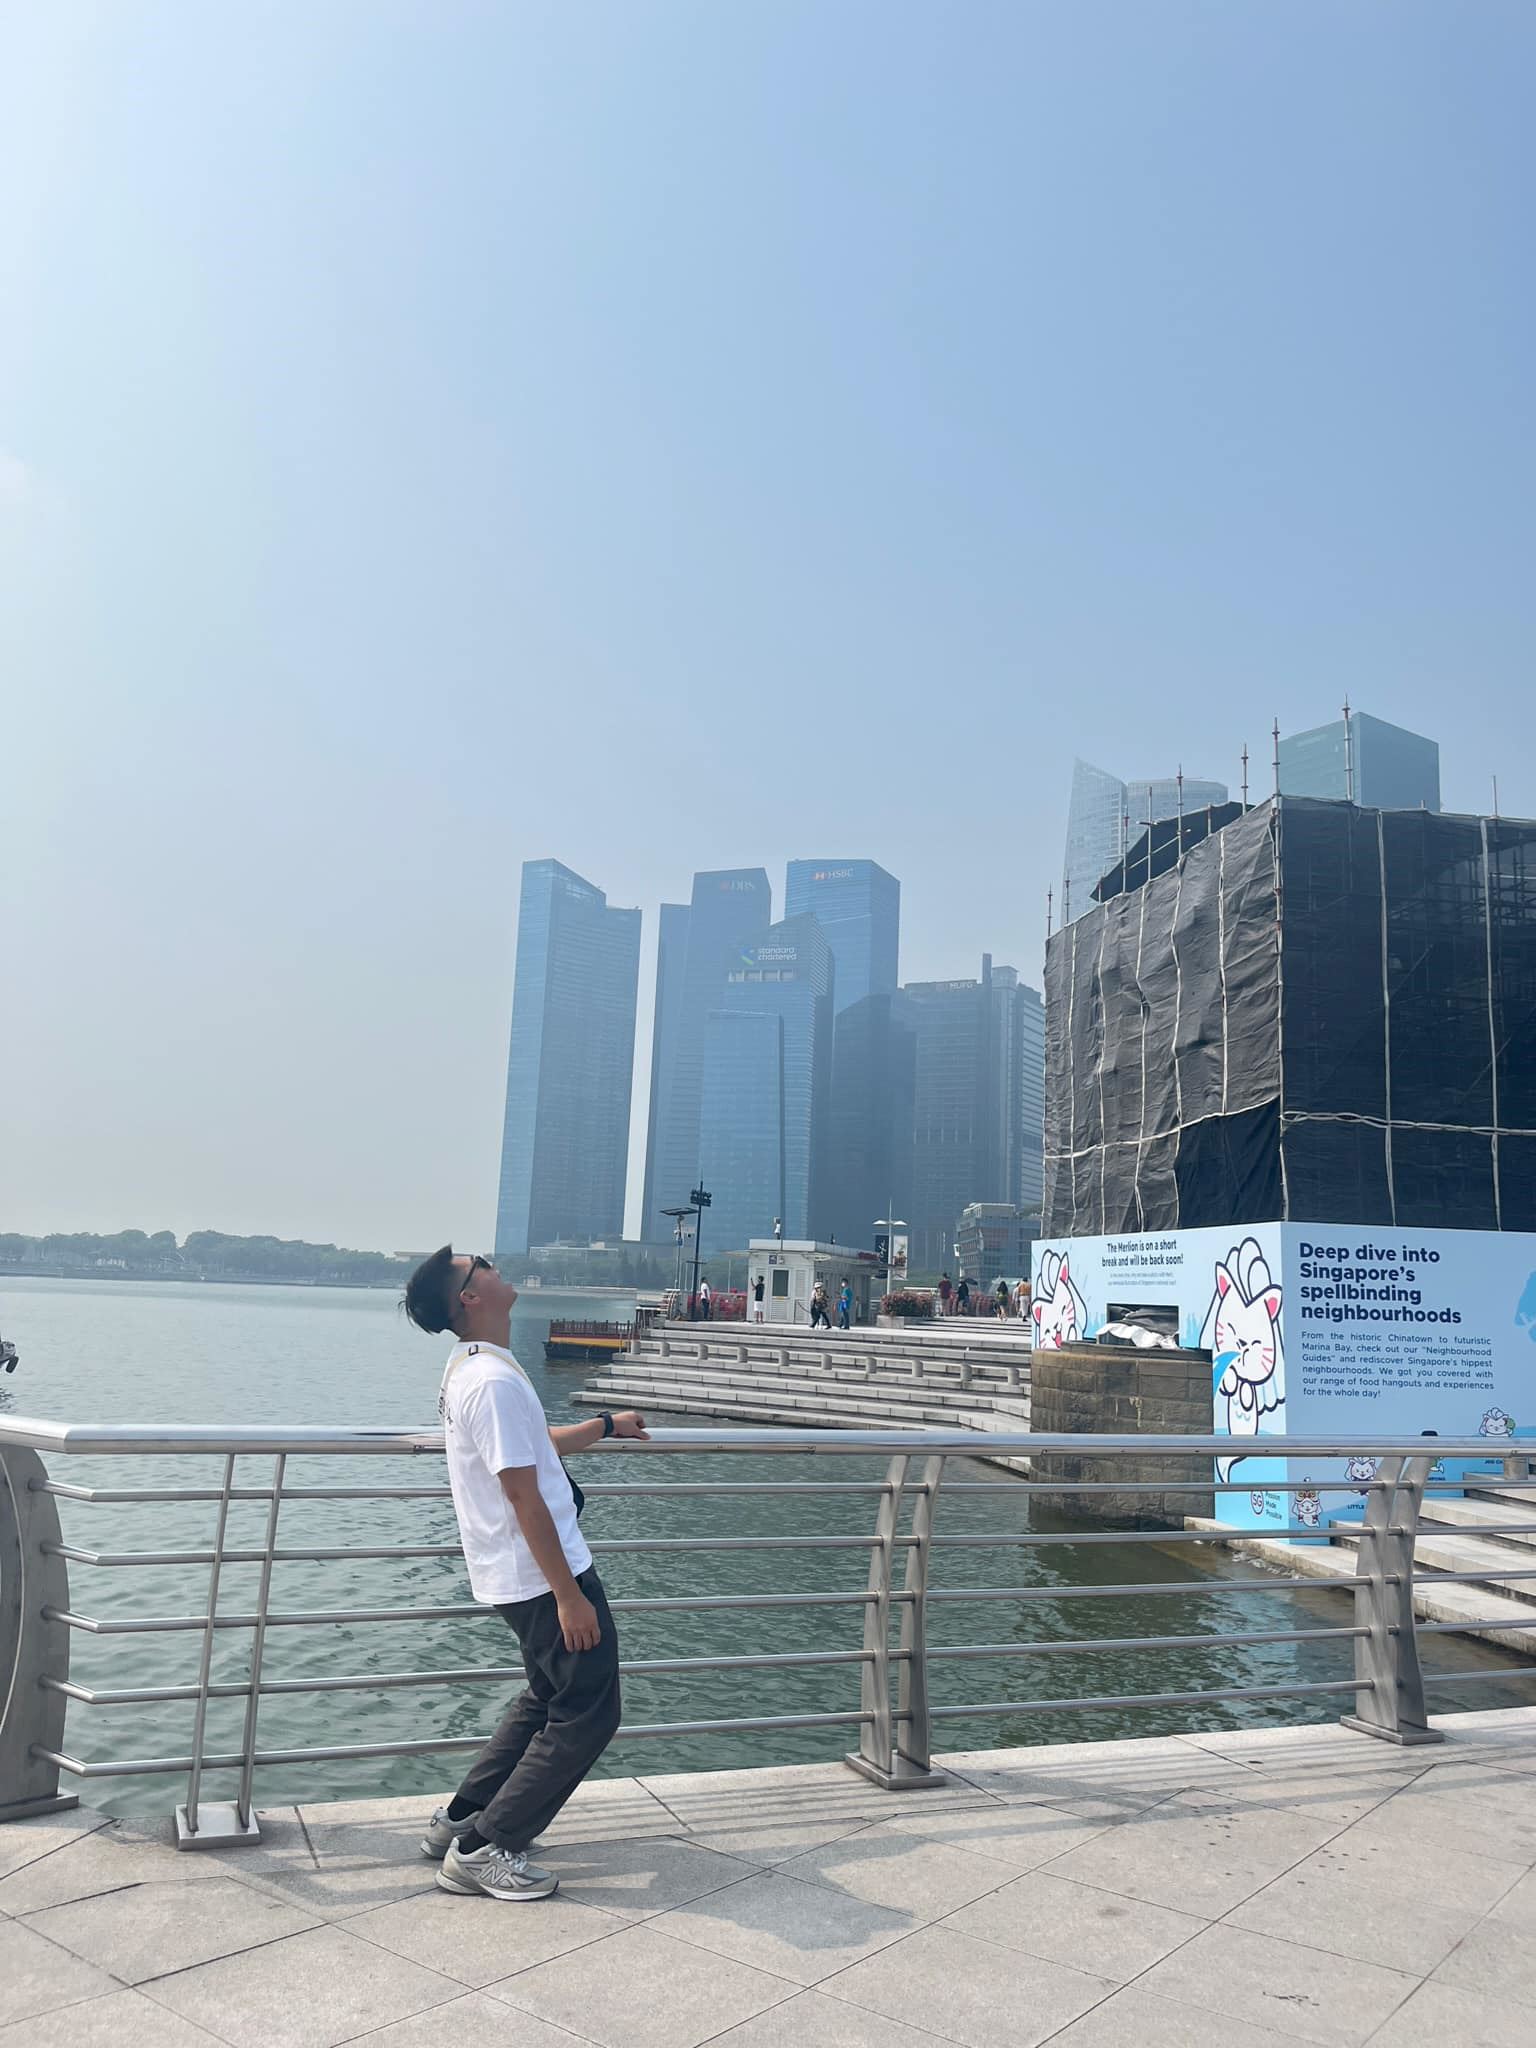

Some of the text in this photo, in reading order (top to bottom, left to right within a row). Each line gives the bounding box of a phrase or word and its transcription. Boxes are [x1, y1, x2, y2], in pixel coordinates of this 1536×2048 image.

[828, 868, 853, 879] HSBC
[1107, 1239, 1176, 1253] The Merlion is on a short
[1299, 1242, 1440, 1263] Deep dive into
[1102, 1252, 1184, 1267] break and will be back soon!
[1300, 1261, 1416, 1283] Singapore's
[1300, 1284, 1422, 1305] spellbinding
[1301, 1302, 1462, 1324] neighbourhoods
[1302, 1331, 1492, 1345] From the historic Chinatown to futuristic
[1302, 1342, 1330, 1351] Marina
[1356, 1344, 1381, 1352] check
[1360, 1356, 1404, 1364] rediscover
[1408, 1356, 1458, 1366] Singapore's
[1461, 1358, 1493, 1368] hippest
[1379, 1367, 1393, 1375] We
[1398, 1368, 1412, 1376] got
[1416, 1370, 1432, 1378] you
[1437, 1370, 1470, 1378] covered
[1475, 1370, 1494, 1378] with
[1320, 1378, 1344, 1386] range
[1360, 1378, 1380, 1386] food
[1382, 1378, 1422, 1388] hangouts
[1425, 1380, 1440, 1388] and
[1443, 1381, 1494, 1390] experiences
[1304, 1388, 1380, 1398] for the whole day!
